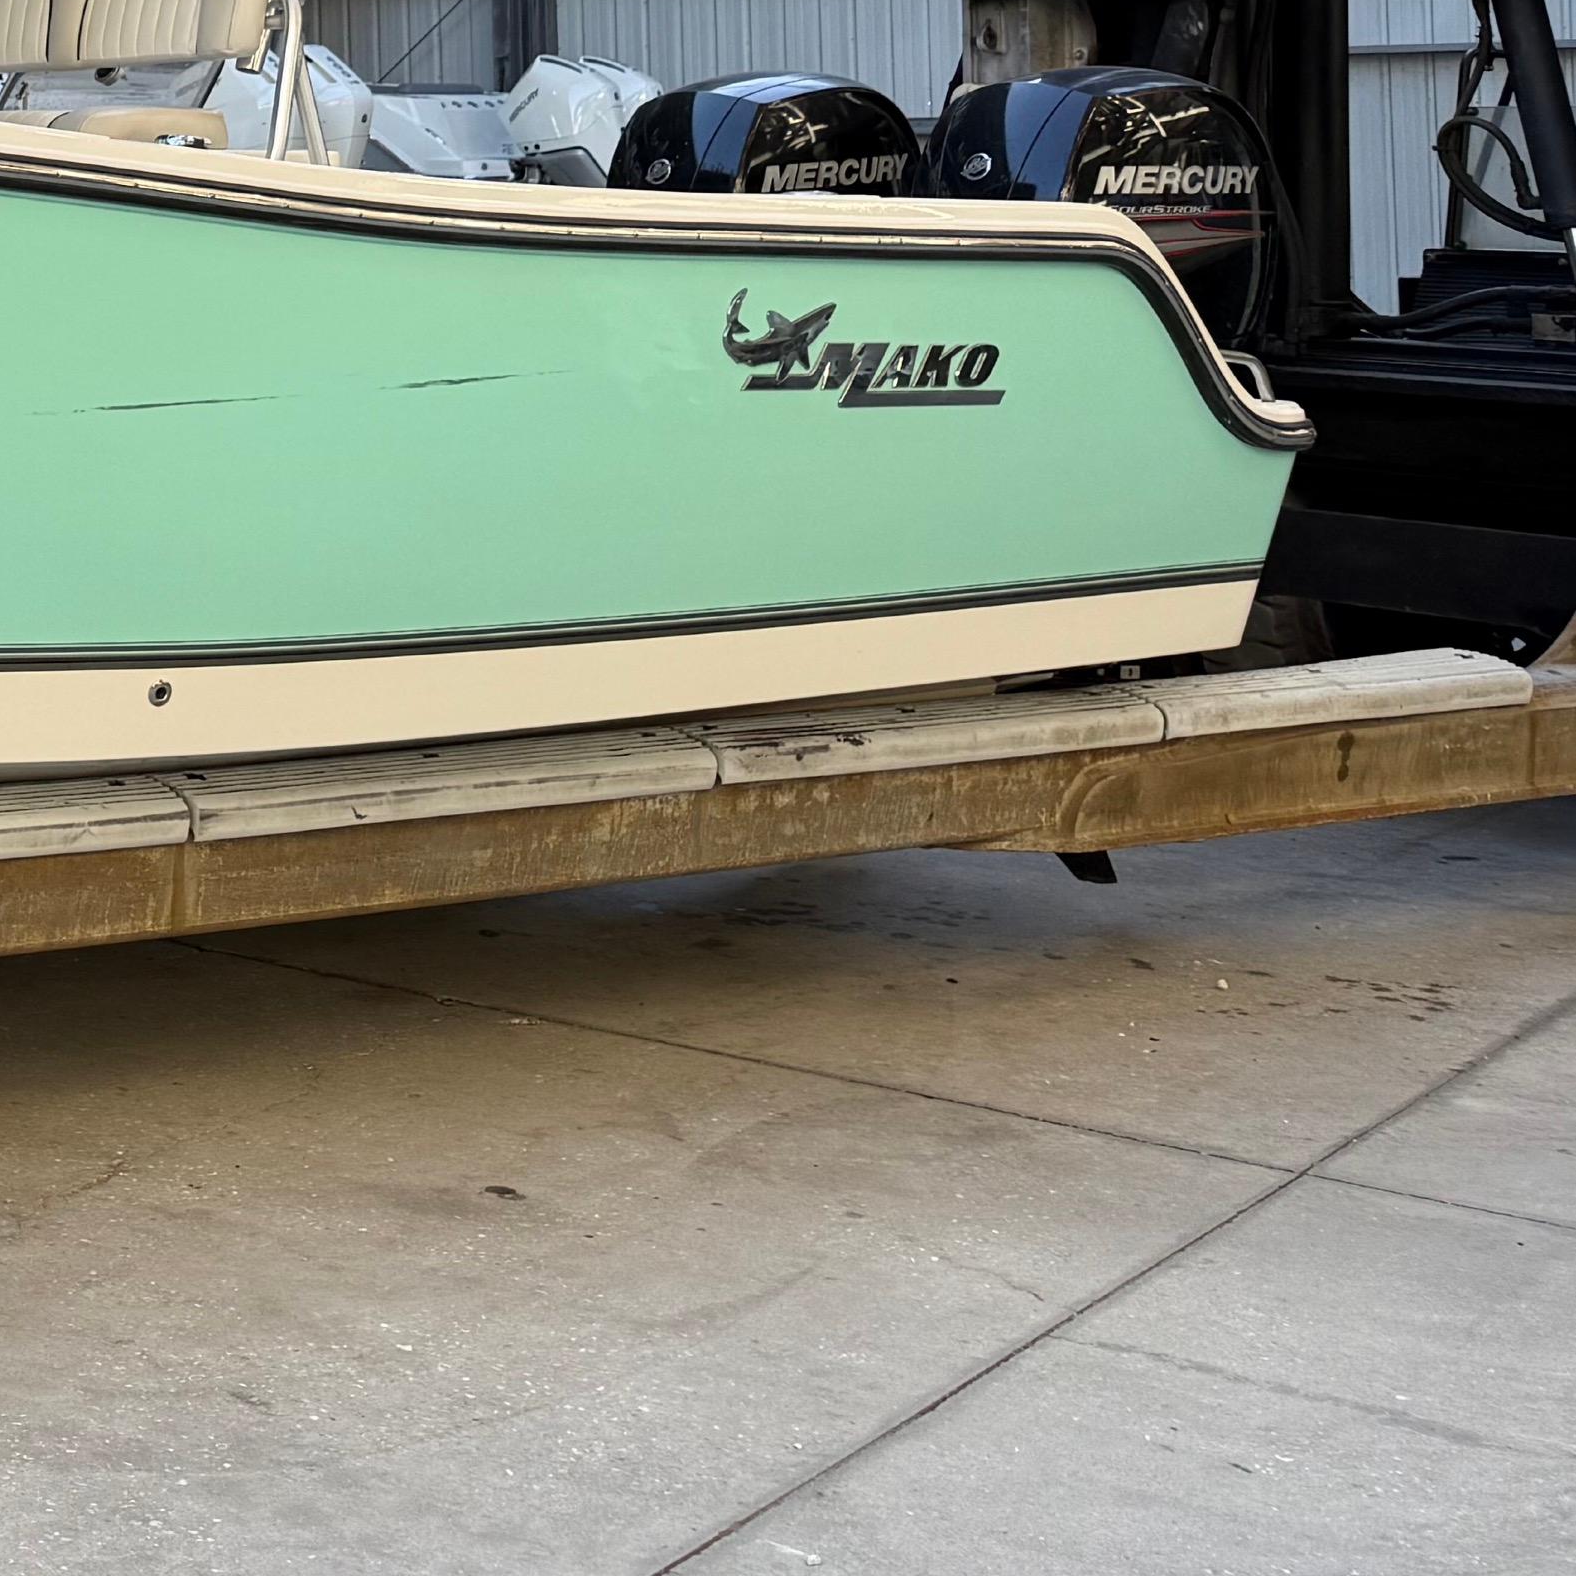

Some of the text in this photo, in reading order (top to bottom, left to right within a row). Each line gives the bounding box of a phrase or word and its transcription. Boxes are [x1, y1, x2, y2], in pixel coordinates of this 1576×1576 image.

[761, 152, 909, 193] MERCURY
[1093, 165, 1259, 195] MERCURY
[816, 342, 1002, 406] MAKO
